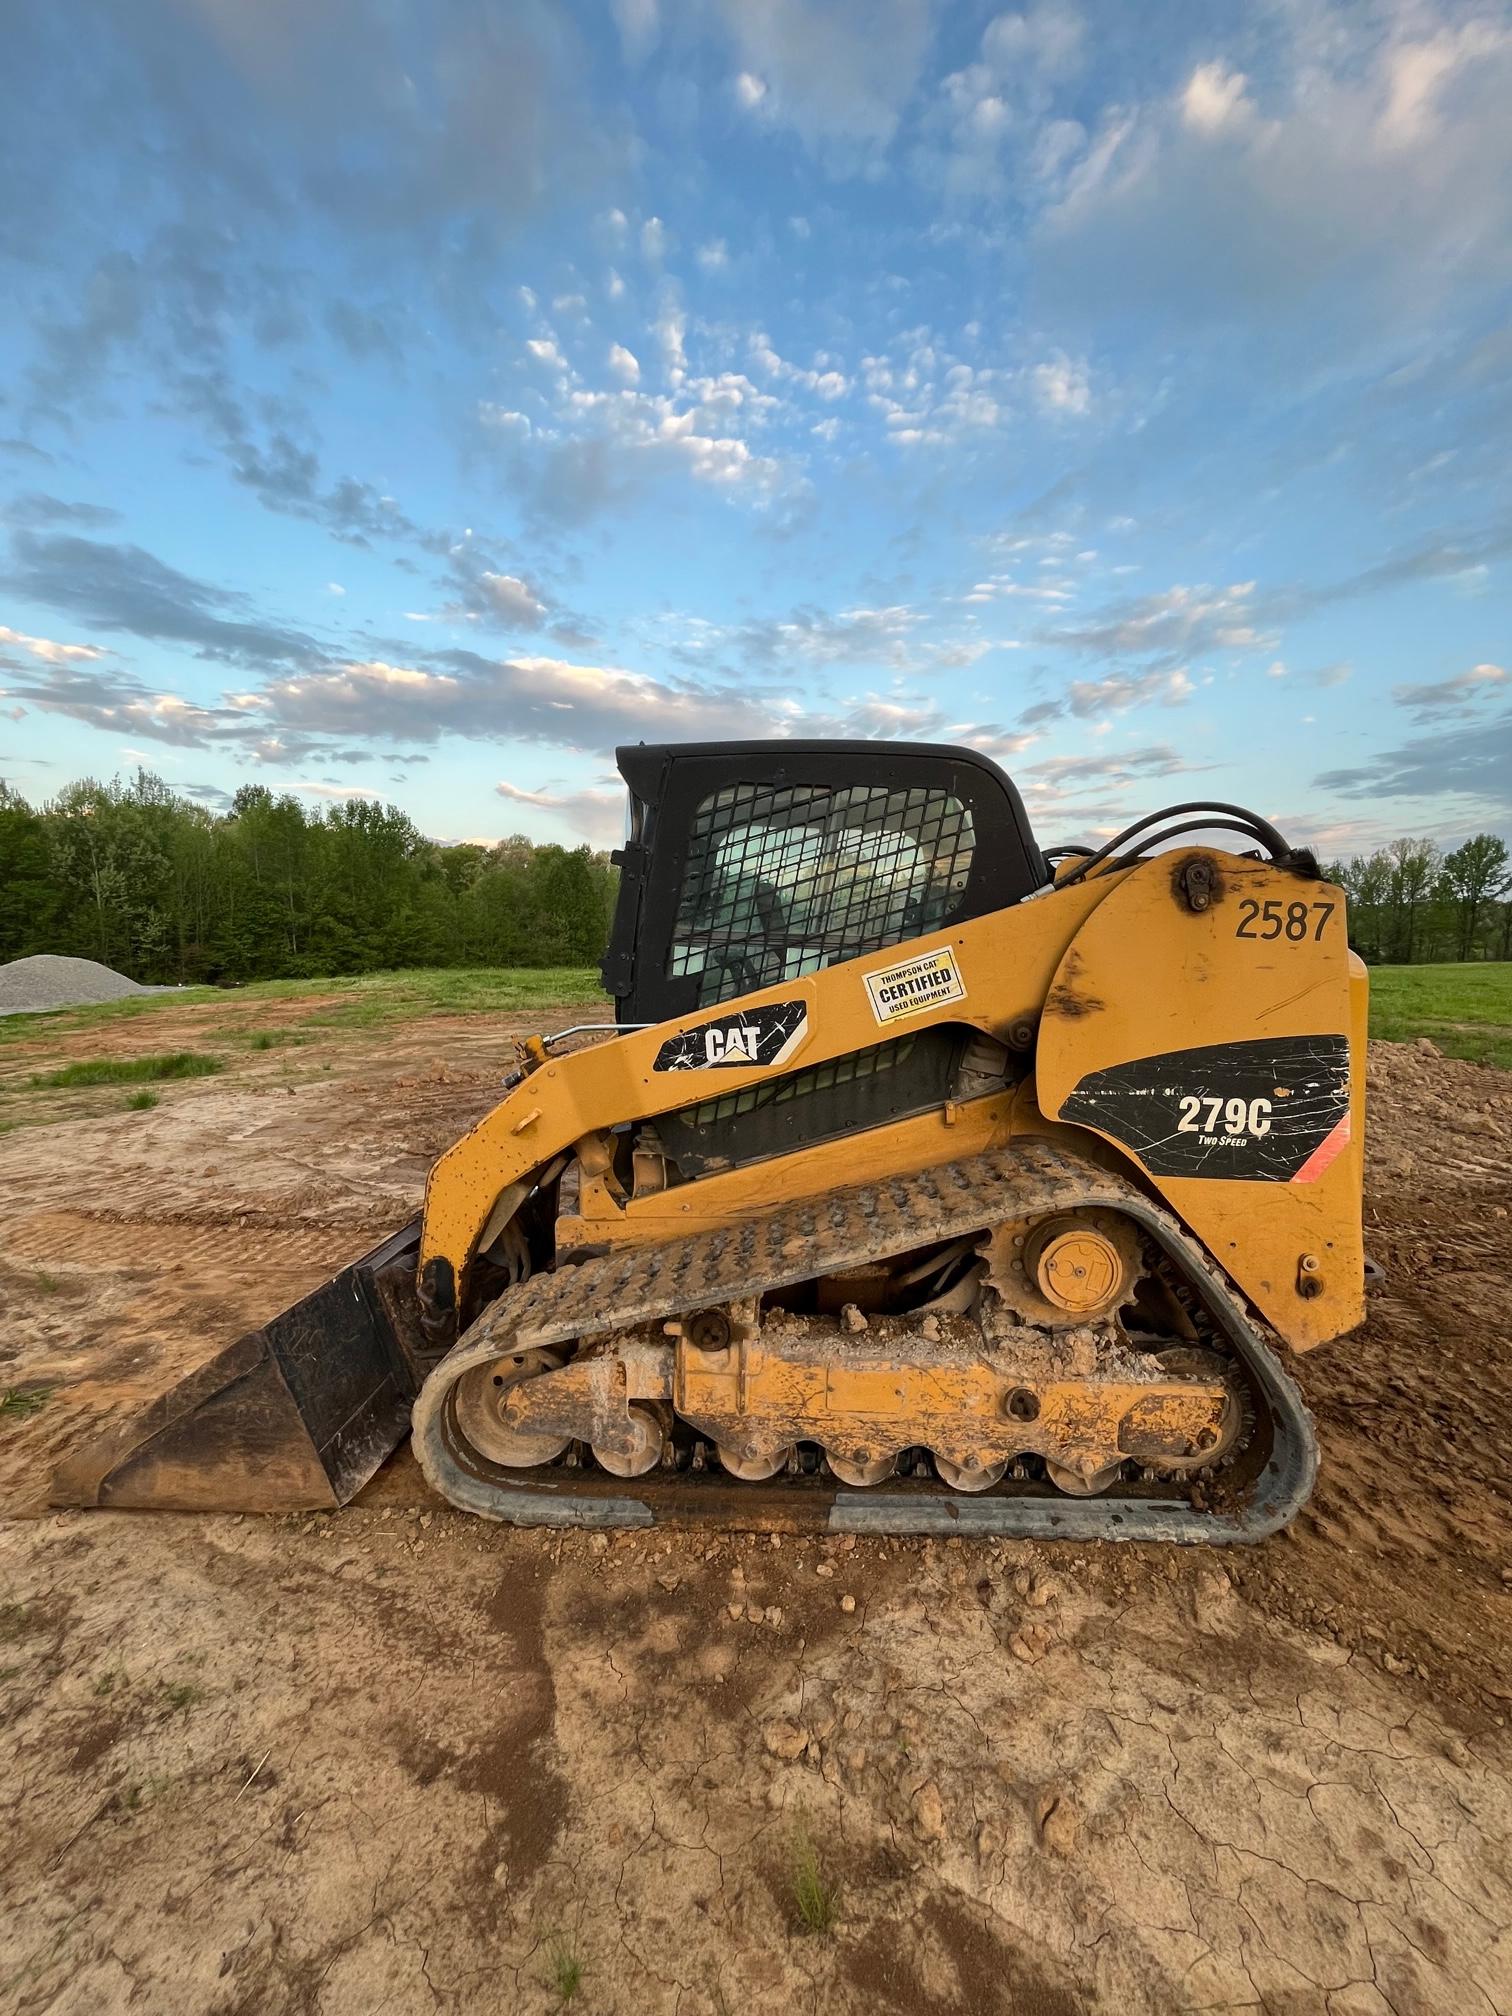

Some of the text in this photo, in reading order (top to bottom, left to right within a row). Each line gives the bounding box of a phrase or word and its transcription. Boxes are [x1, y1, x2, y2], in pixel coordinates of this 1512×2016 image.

[1235, 899, 1335, 942] 2587
[879, 968, 952, 1003] CERTIFIED
[880, 960, 938, 985] THOMPSON CAT
[889, 987, 951, 1013] USED EQUIPMENT
[704, 1027, 761, 1062] CAT
[1177, 1097, 1272, 1134] 279C
